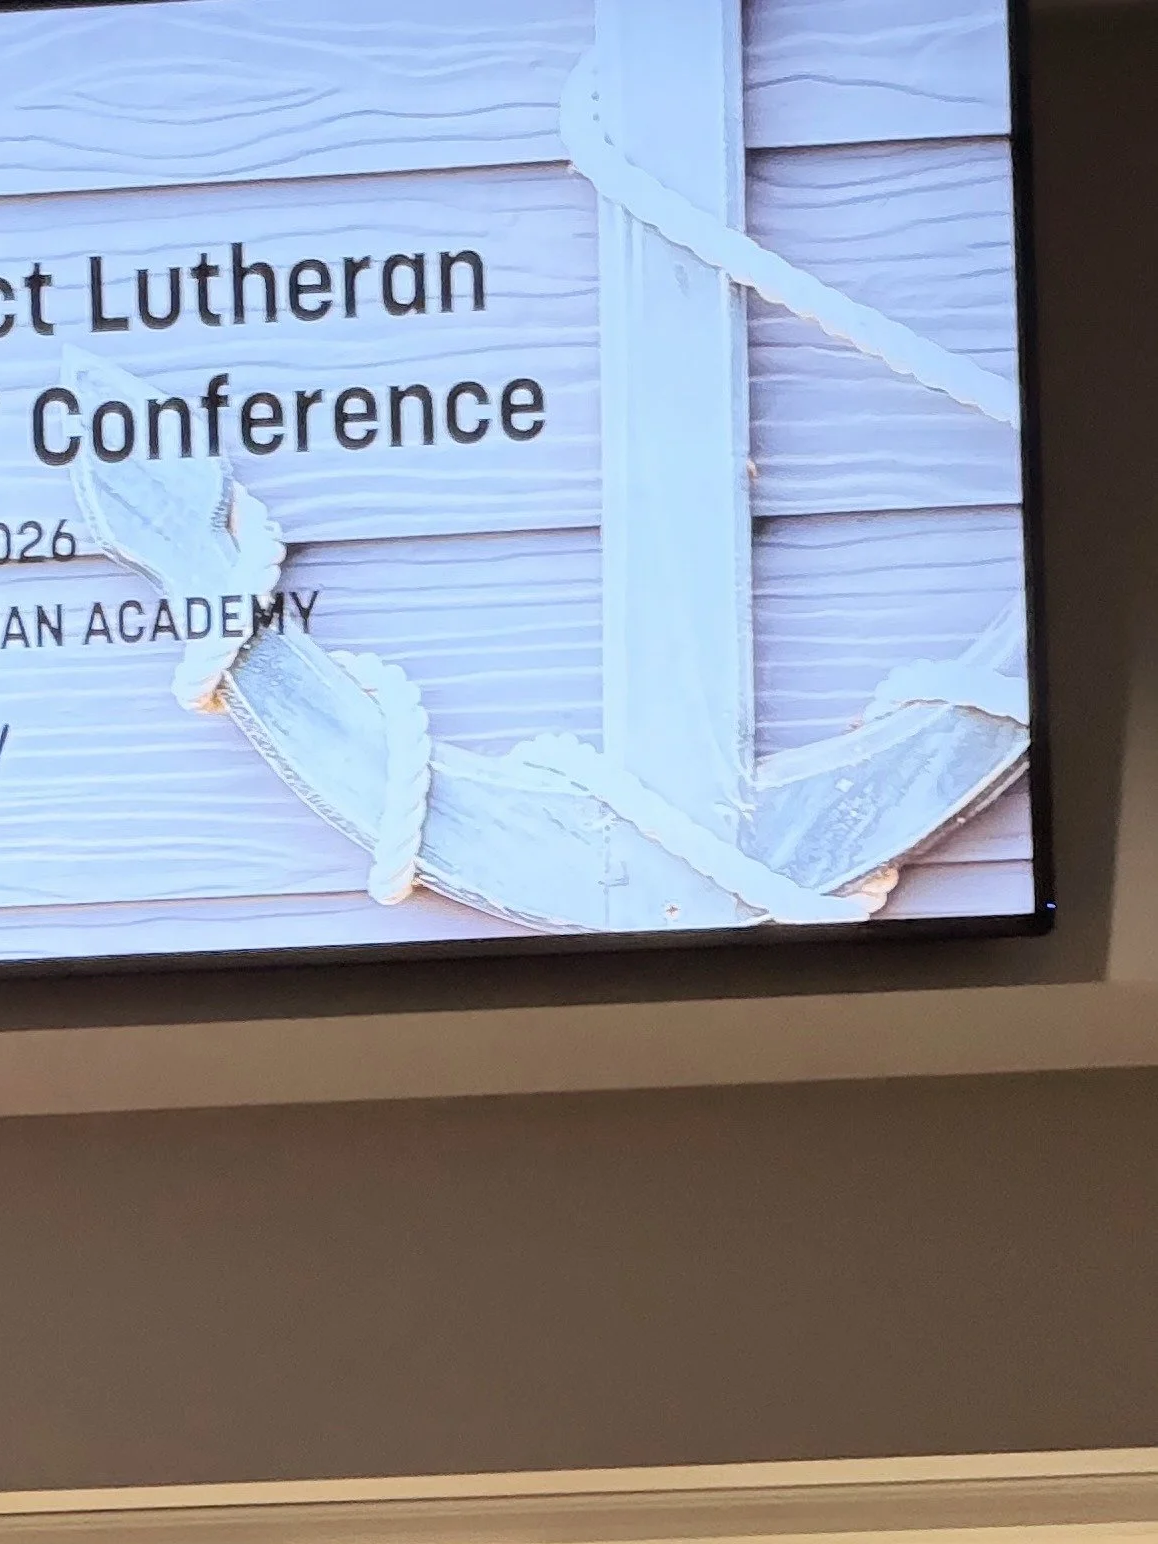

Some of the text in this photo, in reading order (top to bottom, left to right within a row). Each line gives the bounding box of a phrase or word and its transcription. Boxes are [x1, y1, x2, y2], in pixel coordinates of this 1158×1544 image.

[89, 242, 486, 333] Lutheran
[32, 373, 546, 467] Conference
[83, 590, 320, 645] ACADEMY
